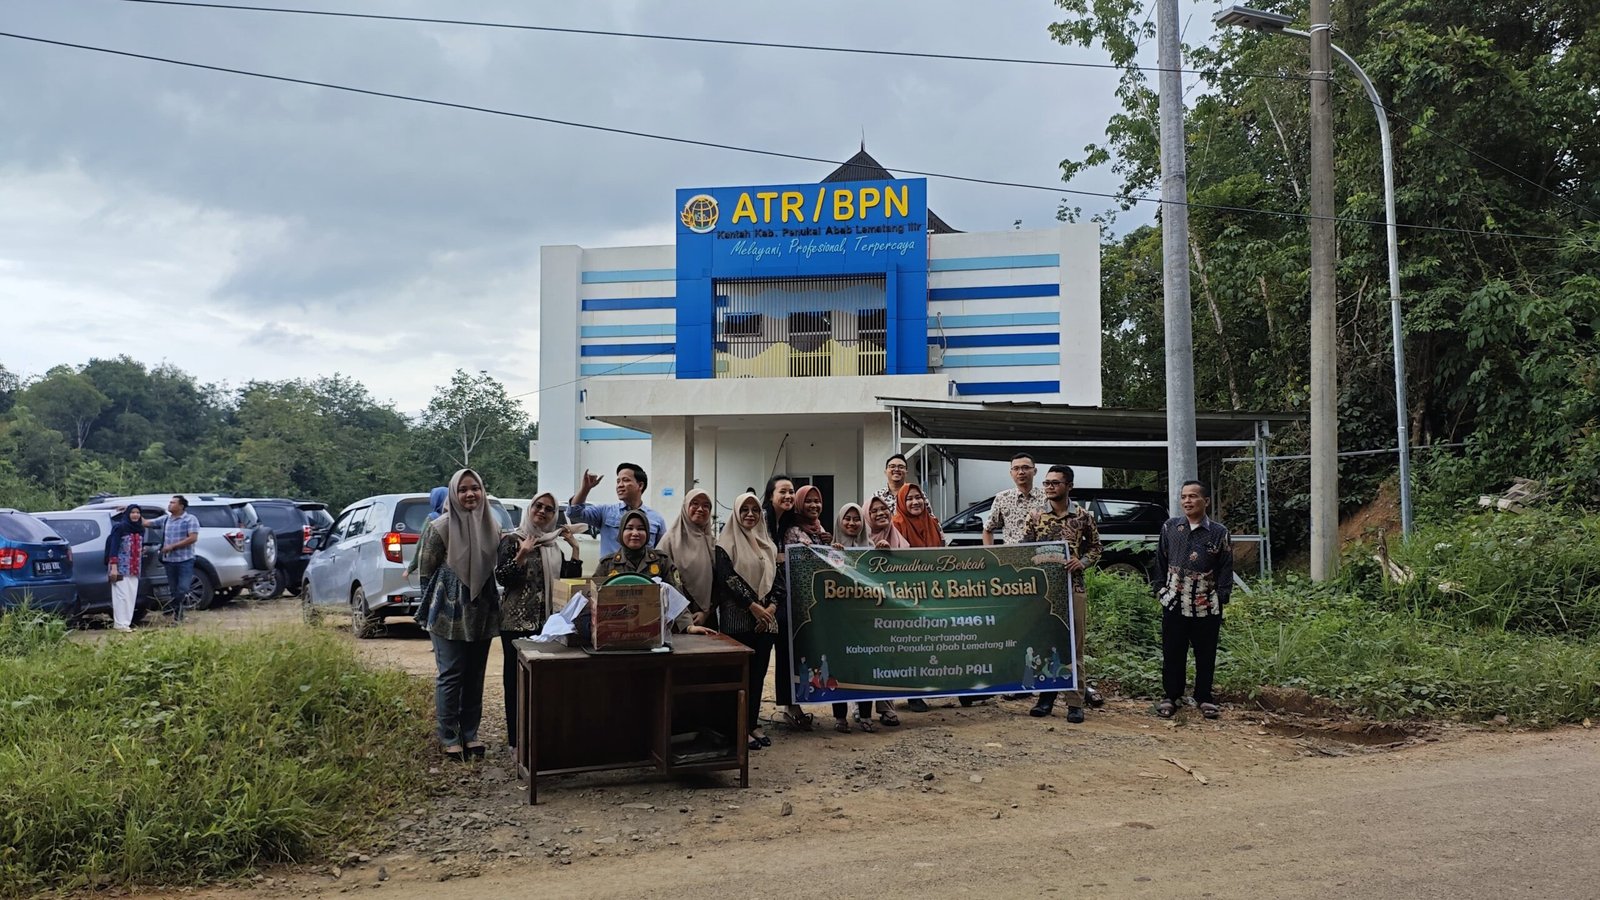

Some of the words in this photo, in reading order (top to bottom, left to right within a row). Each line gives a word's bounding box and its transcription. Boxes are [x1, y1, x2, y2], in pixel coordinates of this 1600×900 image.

[717, 228, 751, 240] Kantah
[754, 228, 778, 238] Kab.
[782, 226, 821, 238] Penukal
[826, 225, 852, 235] Abab
[856, 223, 904, 234] Lematang
[730, 240, 782, 260] Melayani,
[788, 238, 847, 258] Profesional,
[854, 236, 915, 256] Terpercaya
[868, 556, 934, 573] Ramadhan
[936, 554, 986, 572] Berkah
[824, 580, 886, 606] Berbagi
[887, 580, 928, 606] Takjil
[930, 580, 944, 598] &
[946, 578, 987, 598] Bakti
[990, 576, 1037, 596] Sosial
[874, 616, 948, 630] Ramadhan
[950, 616, 982, 626] 1446
[986, 614, 996, 626] H
[890, 634, 923, 643] Kantor
[924, 632, 978, 642] Pertanahan
[846, 644, 895, 655] Kabupaten
[897, 643, 934, 653] Penukal
[936, 642, 960, 652] Abab
[962, 640, 1004, 650] Lematang
[929, 655, 938, 665] &
[872, 666, 916, 679] Ikawati
[920, 664, 963, 677] Kantah
[966, 664, 993, 675] PALI
